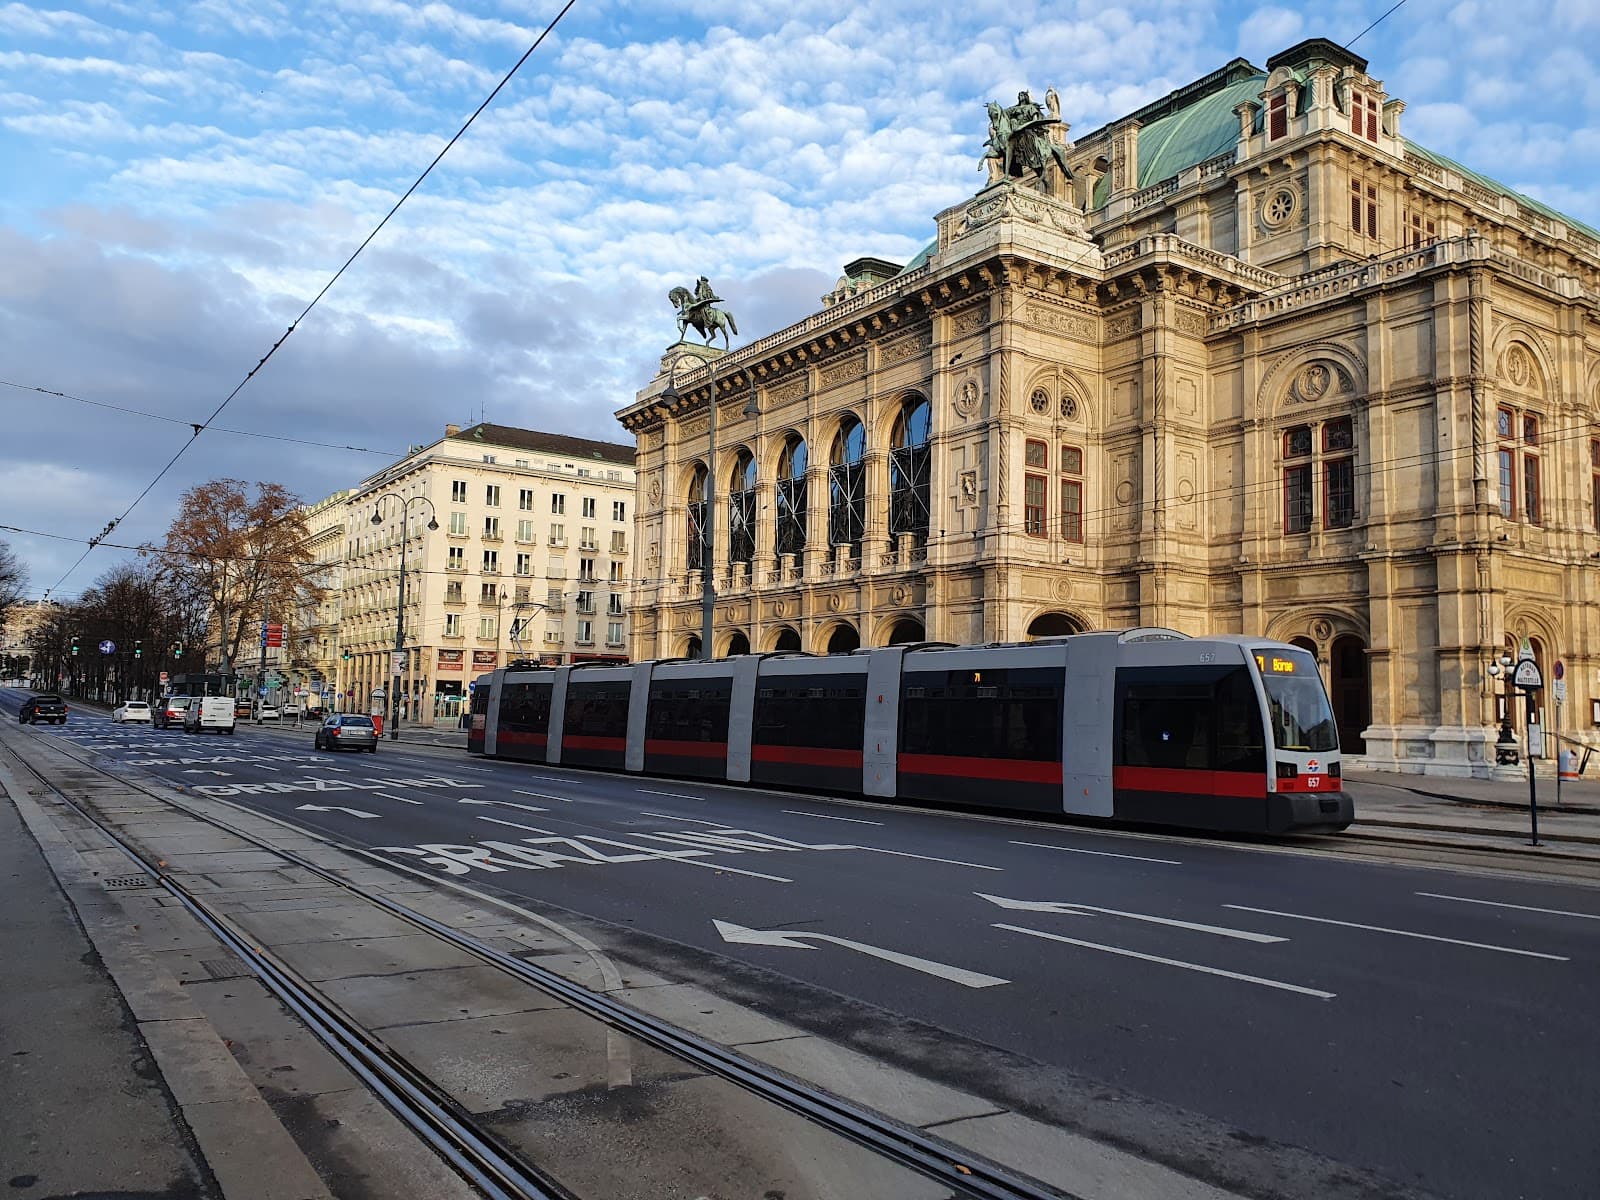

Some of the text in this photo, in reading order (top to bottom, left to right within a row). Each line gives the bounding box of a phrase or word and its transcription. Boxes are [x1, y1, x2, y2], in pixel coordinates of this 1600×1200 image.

[1199, 653, 1216, 663] 657
[1272, 658, 1293, 672] Börse
[191, 777, 486, 796] GRAZ LINZ
[1308, 777, 1320, 787] 657
[368, 829, 857, 875] GRAZ LINZ
